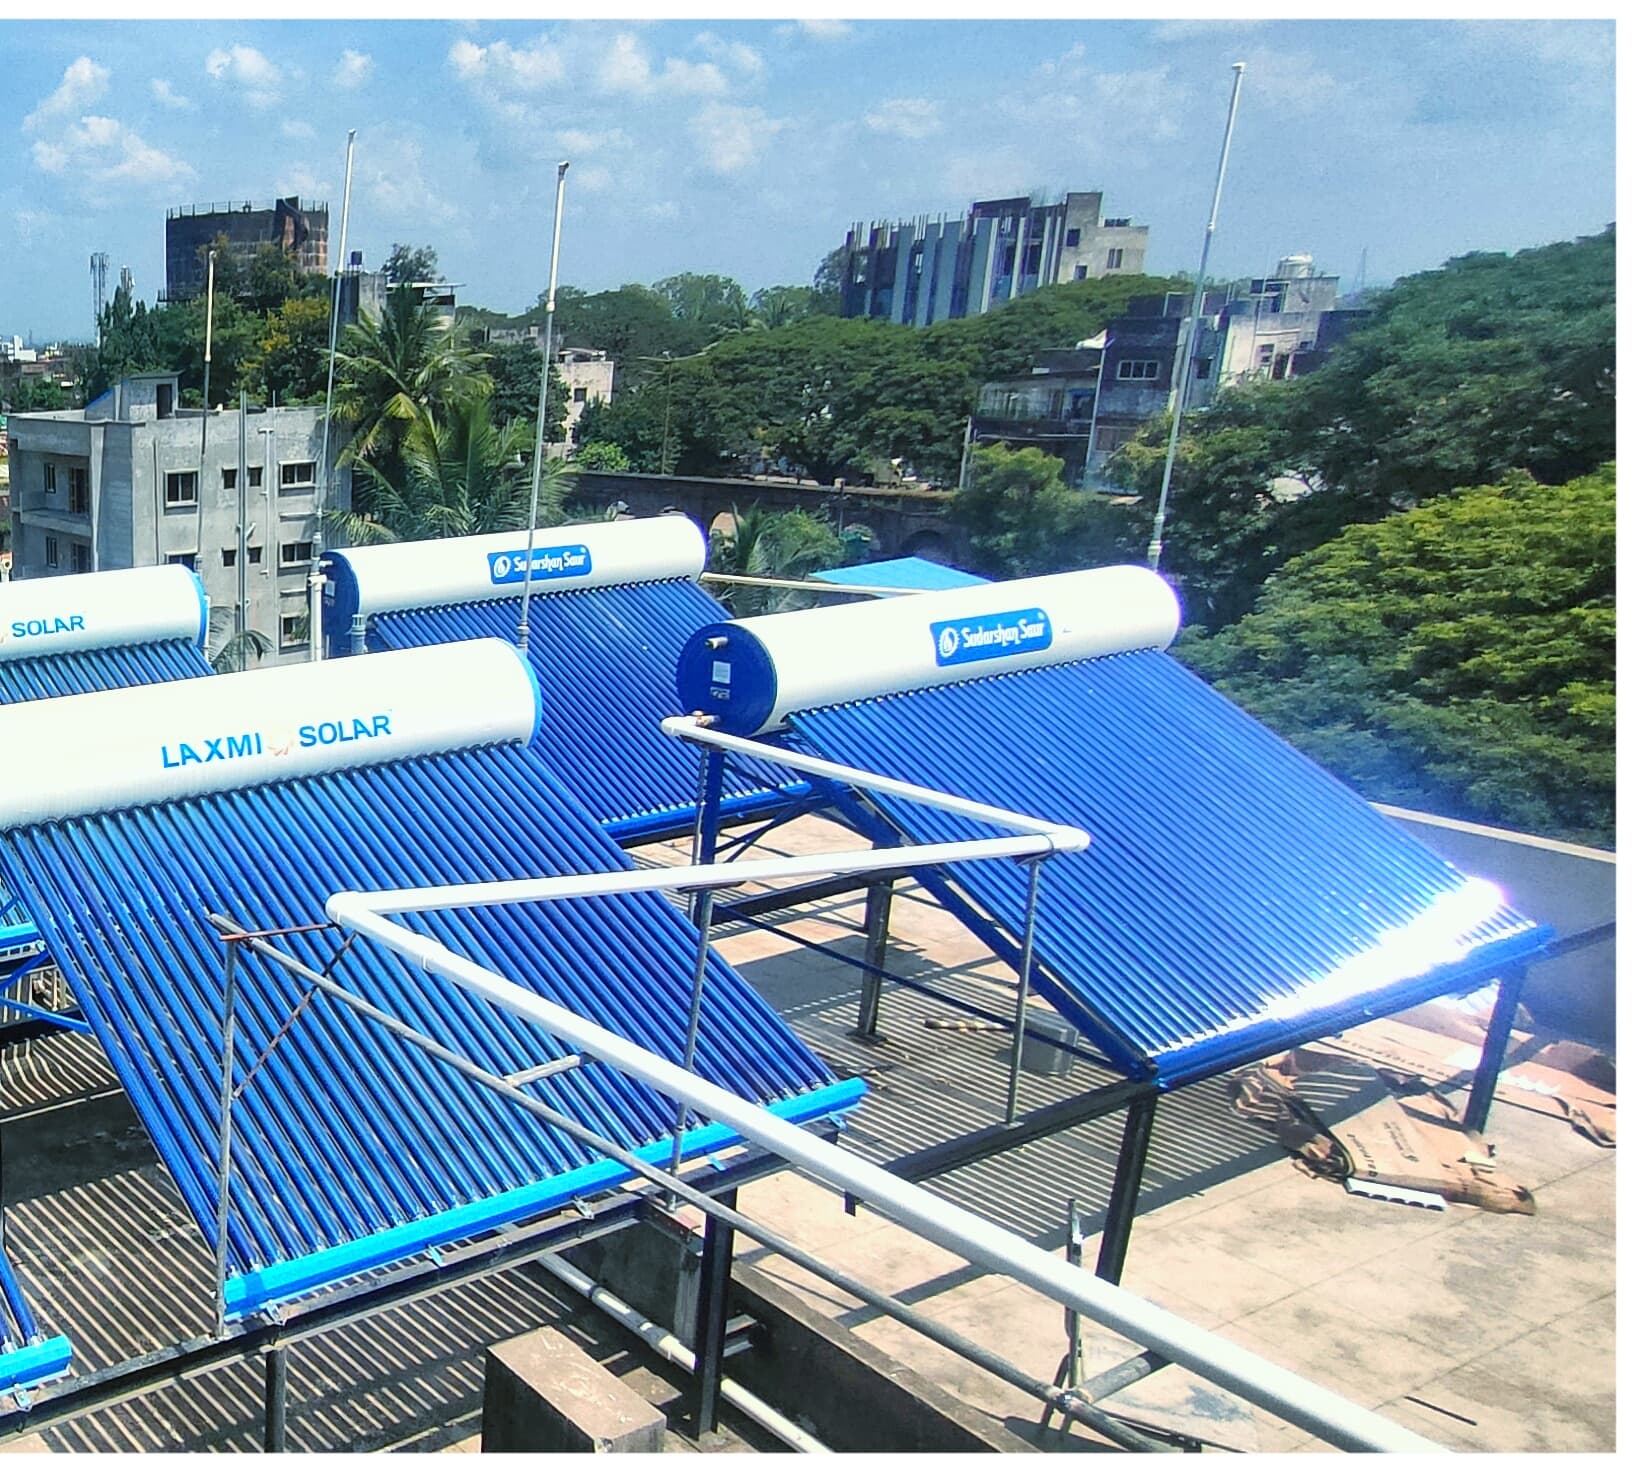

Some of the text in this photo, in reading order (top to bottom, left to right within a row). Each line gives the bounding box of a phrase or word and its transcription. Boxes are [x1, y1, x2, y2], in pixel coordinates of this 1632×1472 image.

[513, 553, 564, 573] Suarshan
[11, 615, 85, 637] SOLAR
[960, 622, 1021, 647] Sudarshan
[161, 715, 392, 768] LAXMI SOLAR
